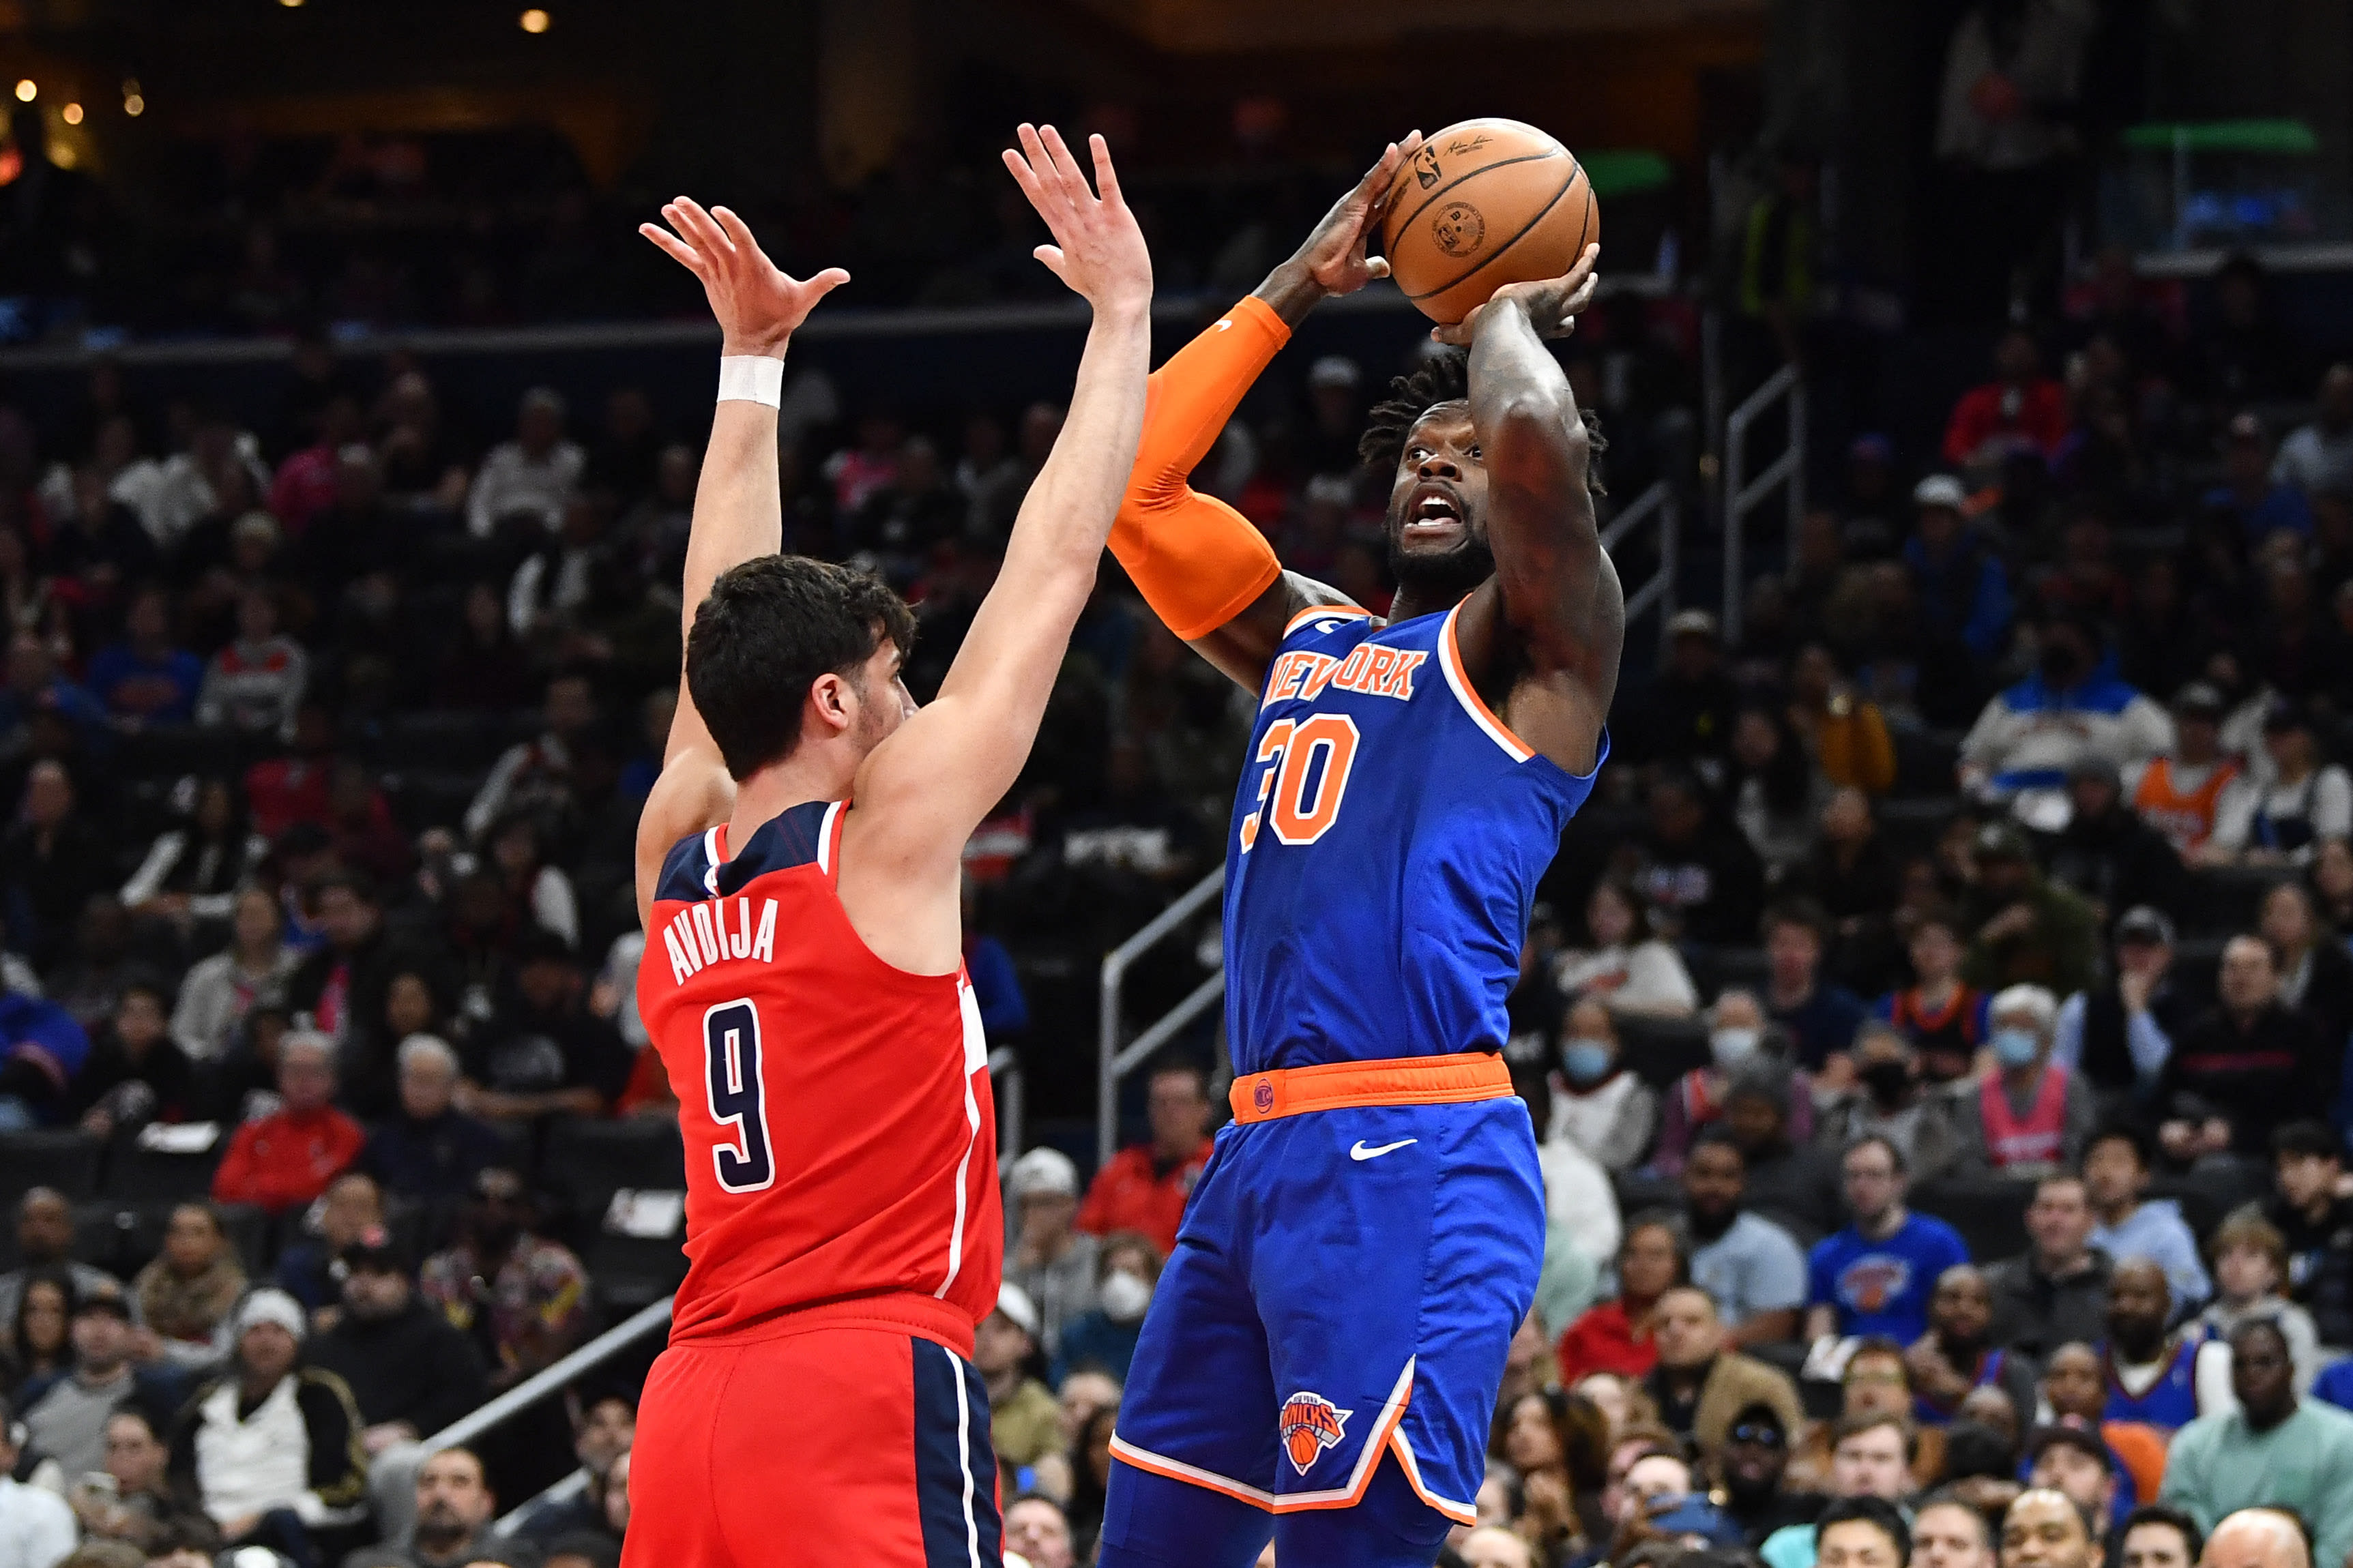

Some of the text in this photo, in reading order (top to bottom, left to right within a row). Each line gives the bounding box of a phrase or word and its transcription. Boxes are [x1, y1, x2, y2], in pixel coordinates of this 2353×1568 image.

[1330, 642, 1429, 701] ORK
[1240, 713, 1360, 854] 30
[662, 897, 778, 986] AVDIJA
[703, 997, 776, 1194] 9
